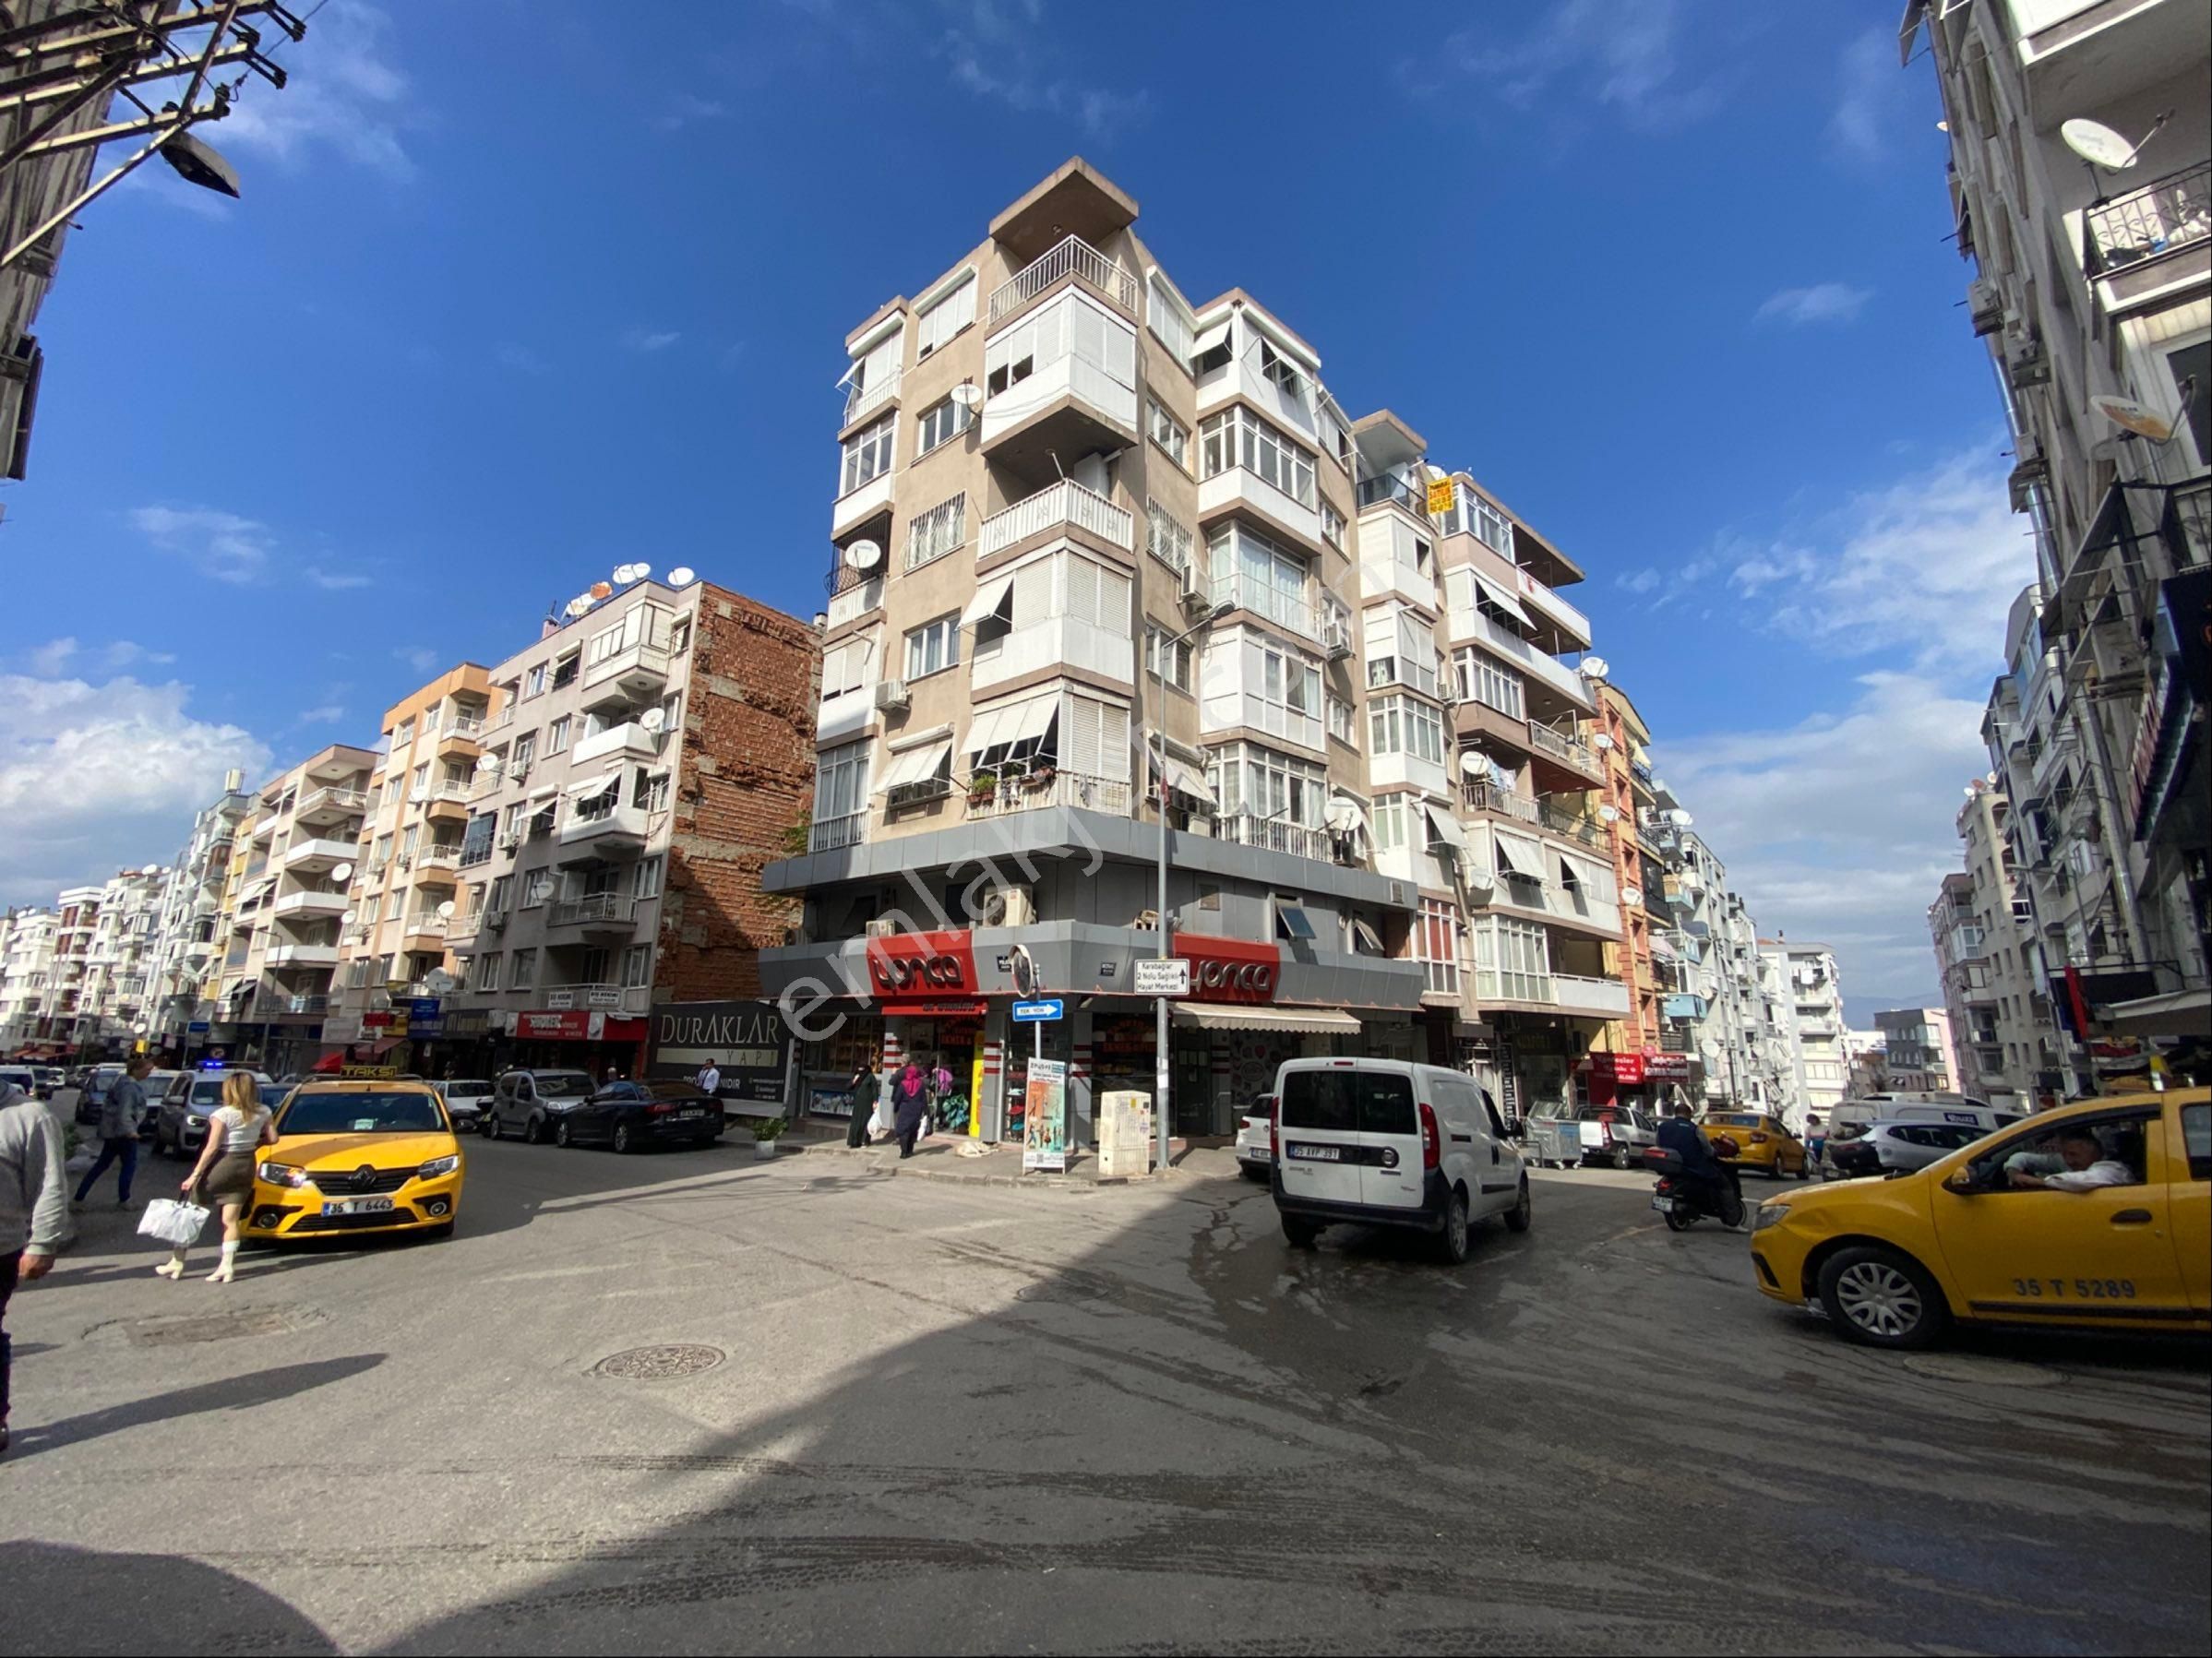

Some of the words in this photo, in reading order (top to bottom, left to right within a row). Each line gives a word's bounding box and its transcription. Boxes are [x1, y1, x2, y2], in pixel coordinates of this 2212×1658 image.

[873, 954, 963, 992] yonca
[1138, 983, 1154, 991] Hayat
[659, 1013, 780, 1044] DURAKLAR
[727, 1050, 774, 1066] YAPI
[330, 1202, 344, 1213] 35
[365, 1199, 393, 1211] 6443
[2013, 1279, 2042, 1296] 35
[2050, 1279, 2064, 1297] T
[2075, 1279, 2135, 1298] 5289
